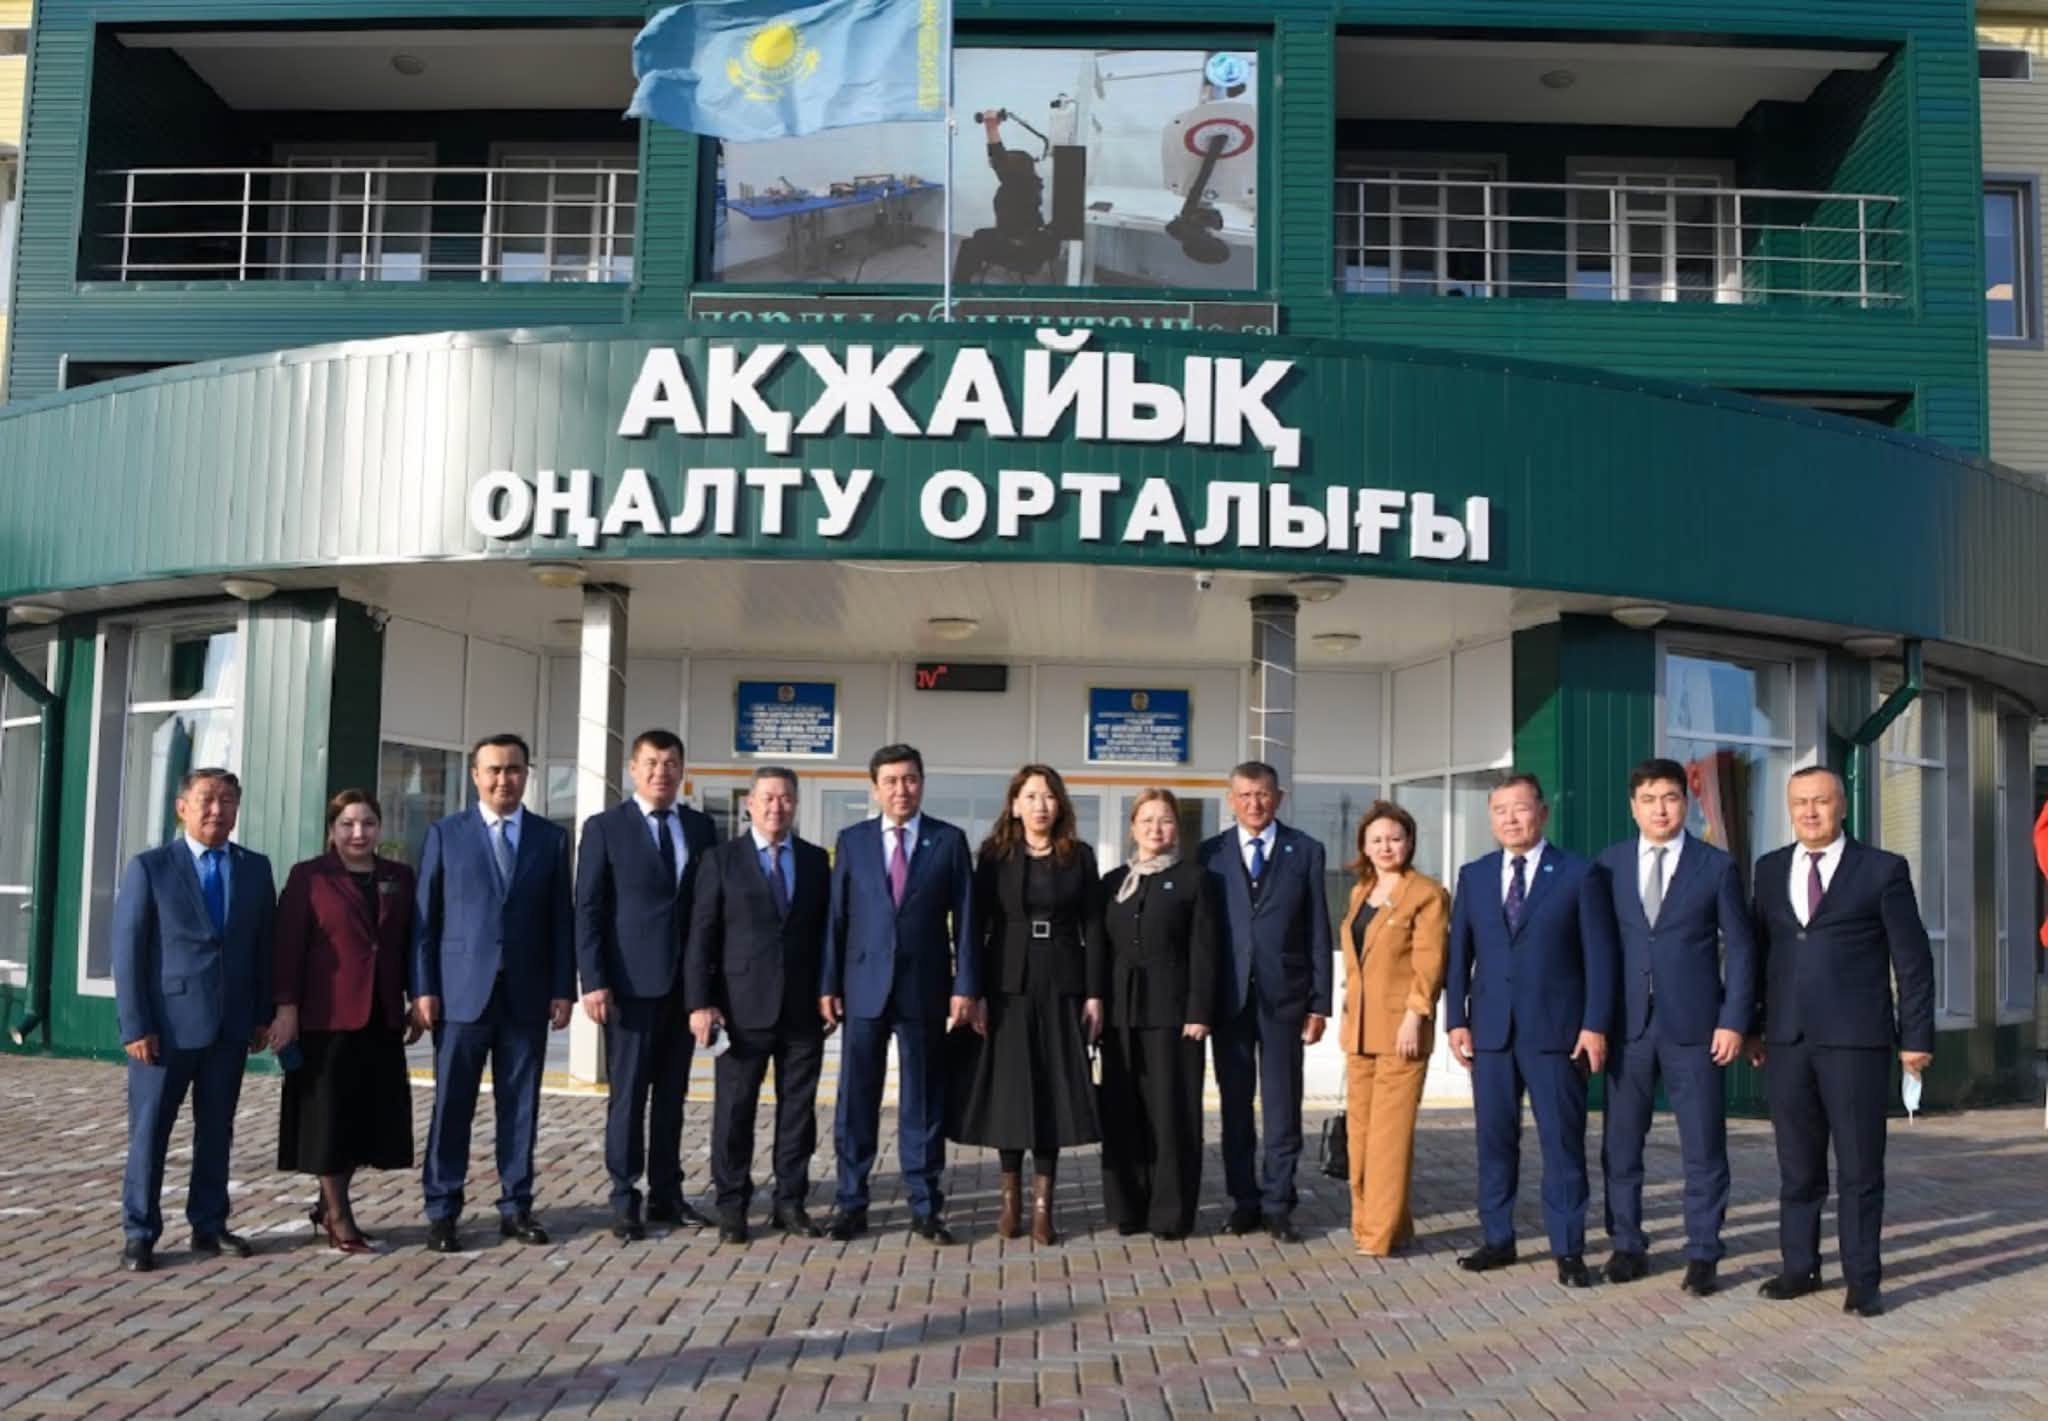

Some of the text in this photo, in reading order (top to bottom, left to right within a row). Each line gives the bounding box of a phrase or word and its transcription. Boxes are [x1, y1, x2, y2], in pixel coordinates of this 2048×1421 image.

[617, 329, 1300, 467] АҚЖАЙЫҚ
[469, 467, 1490, 561] ОҢАЛТУ ОРТАЛЫҒЫ
